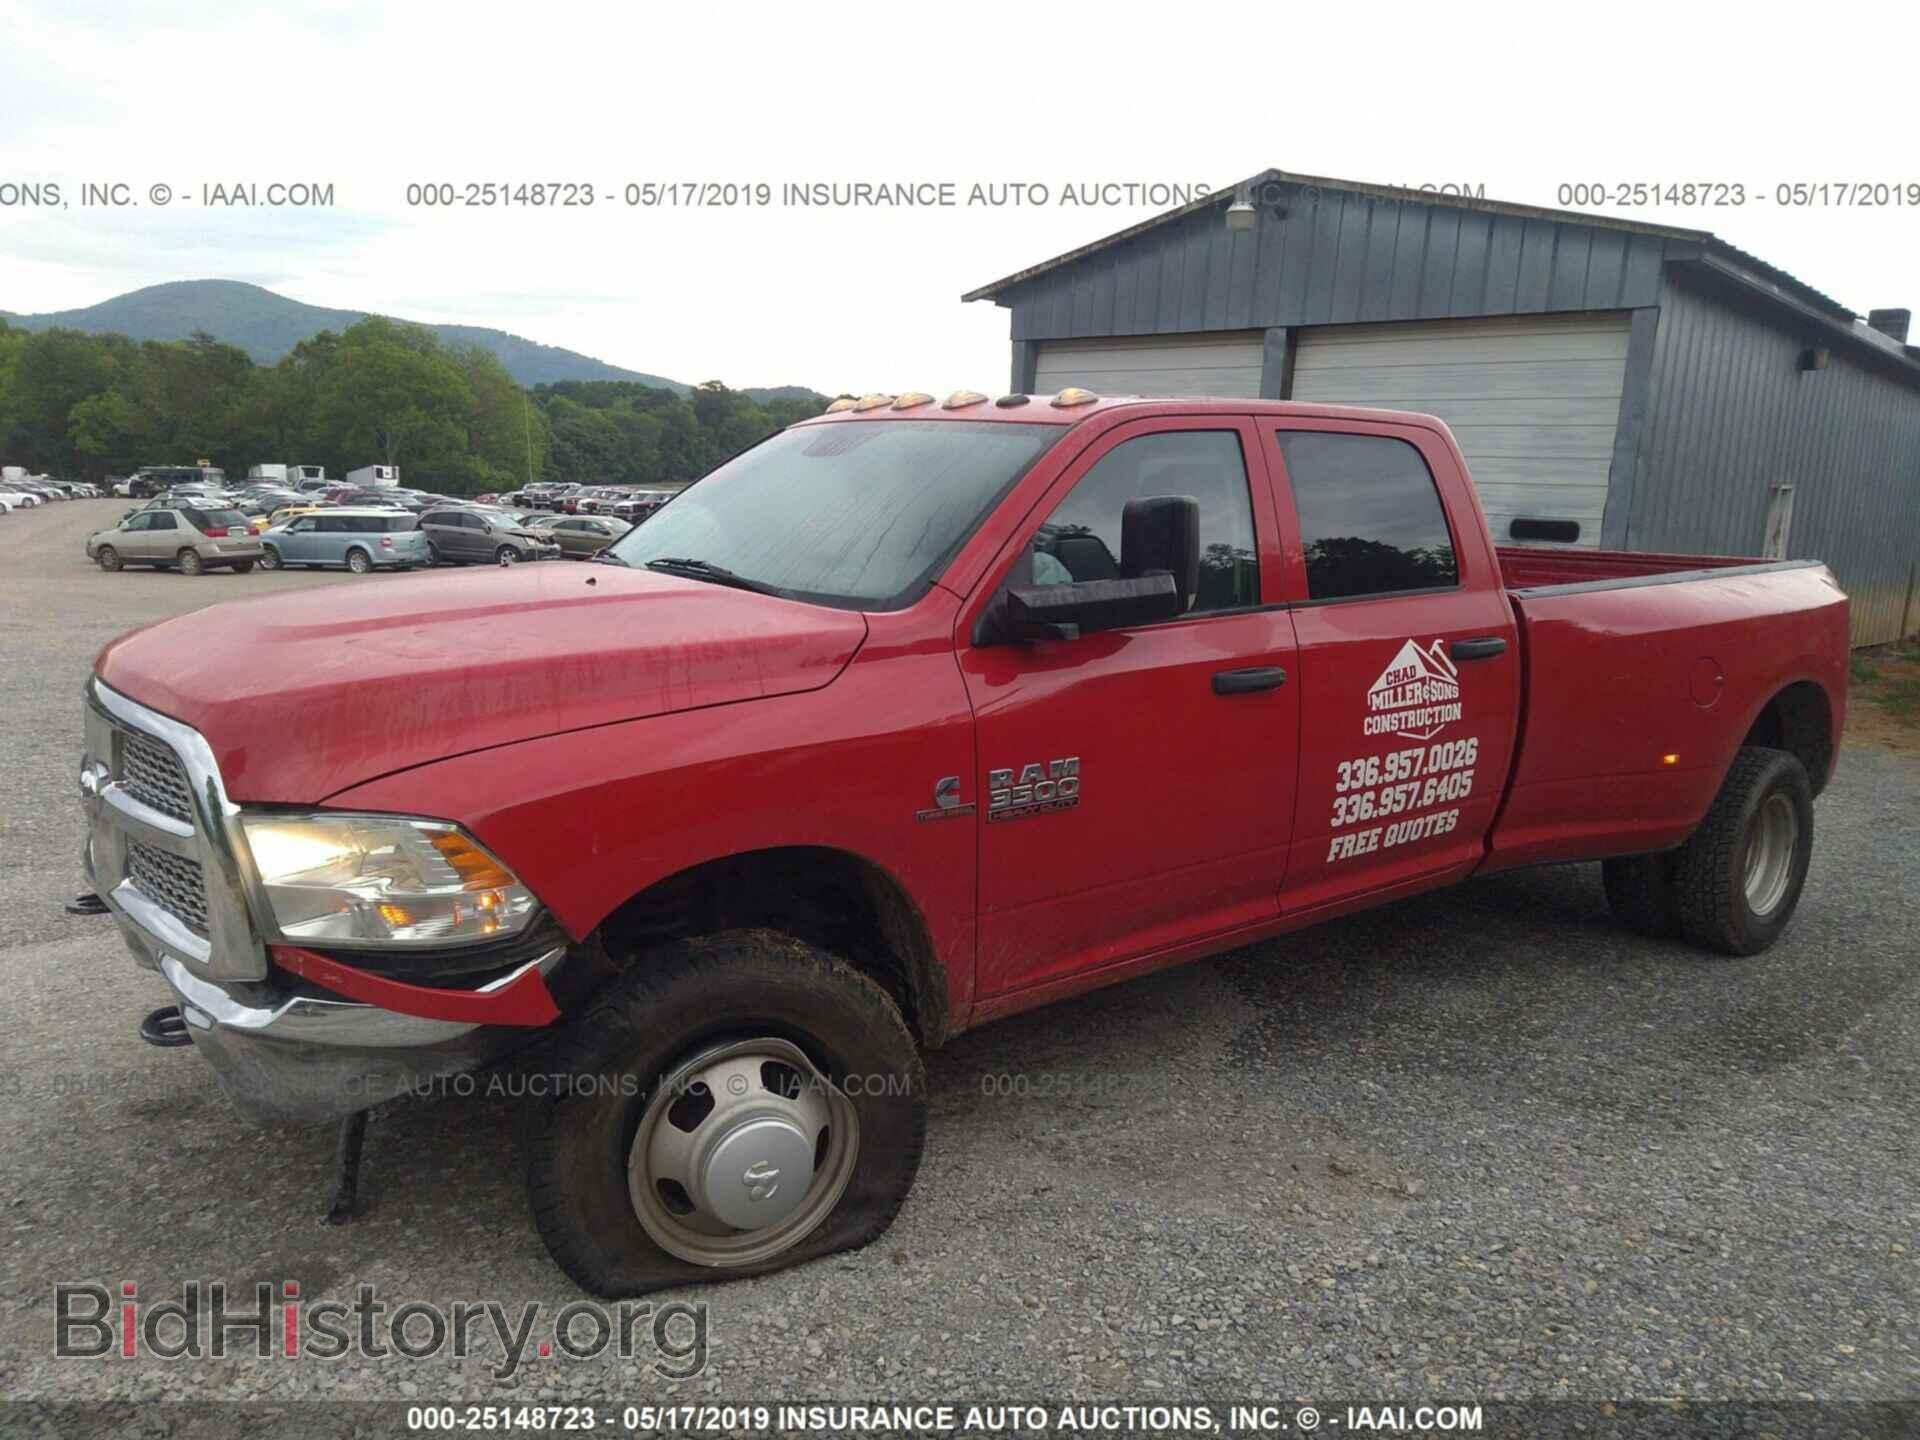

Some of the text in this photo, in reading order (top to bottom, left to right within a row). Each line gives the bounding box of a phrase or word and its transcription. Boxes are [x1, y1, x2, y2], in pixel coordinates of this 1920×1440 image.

[1386, 665, 1416, 685] CHAD
[1364, 703, 1461, 735] CONSTRUCTION
[989, 756, 1080, 790] RAM
[1336, 737, 1478, 792] 336.957.0026
[990, 777, 1079, 808] 3500
[1331, 769, 1474, 827] 336.957.6405
[1326, 808, 1459, 863] FREE QUOTES
